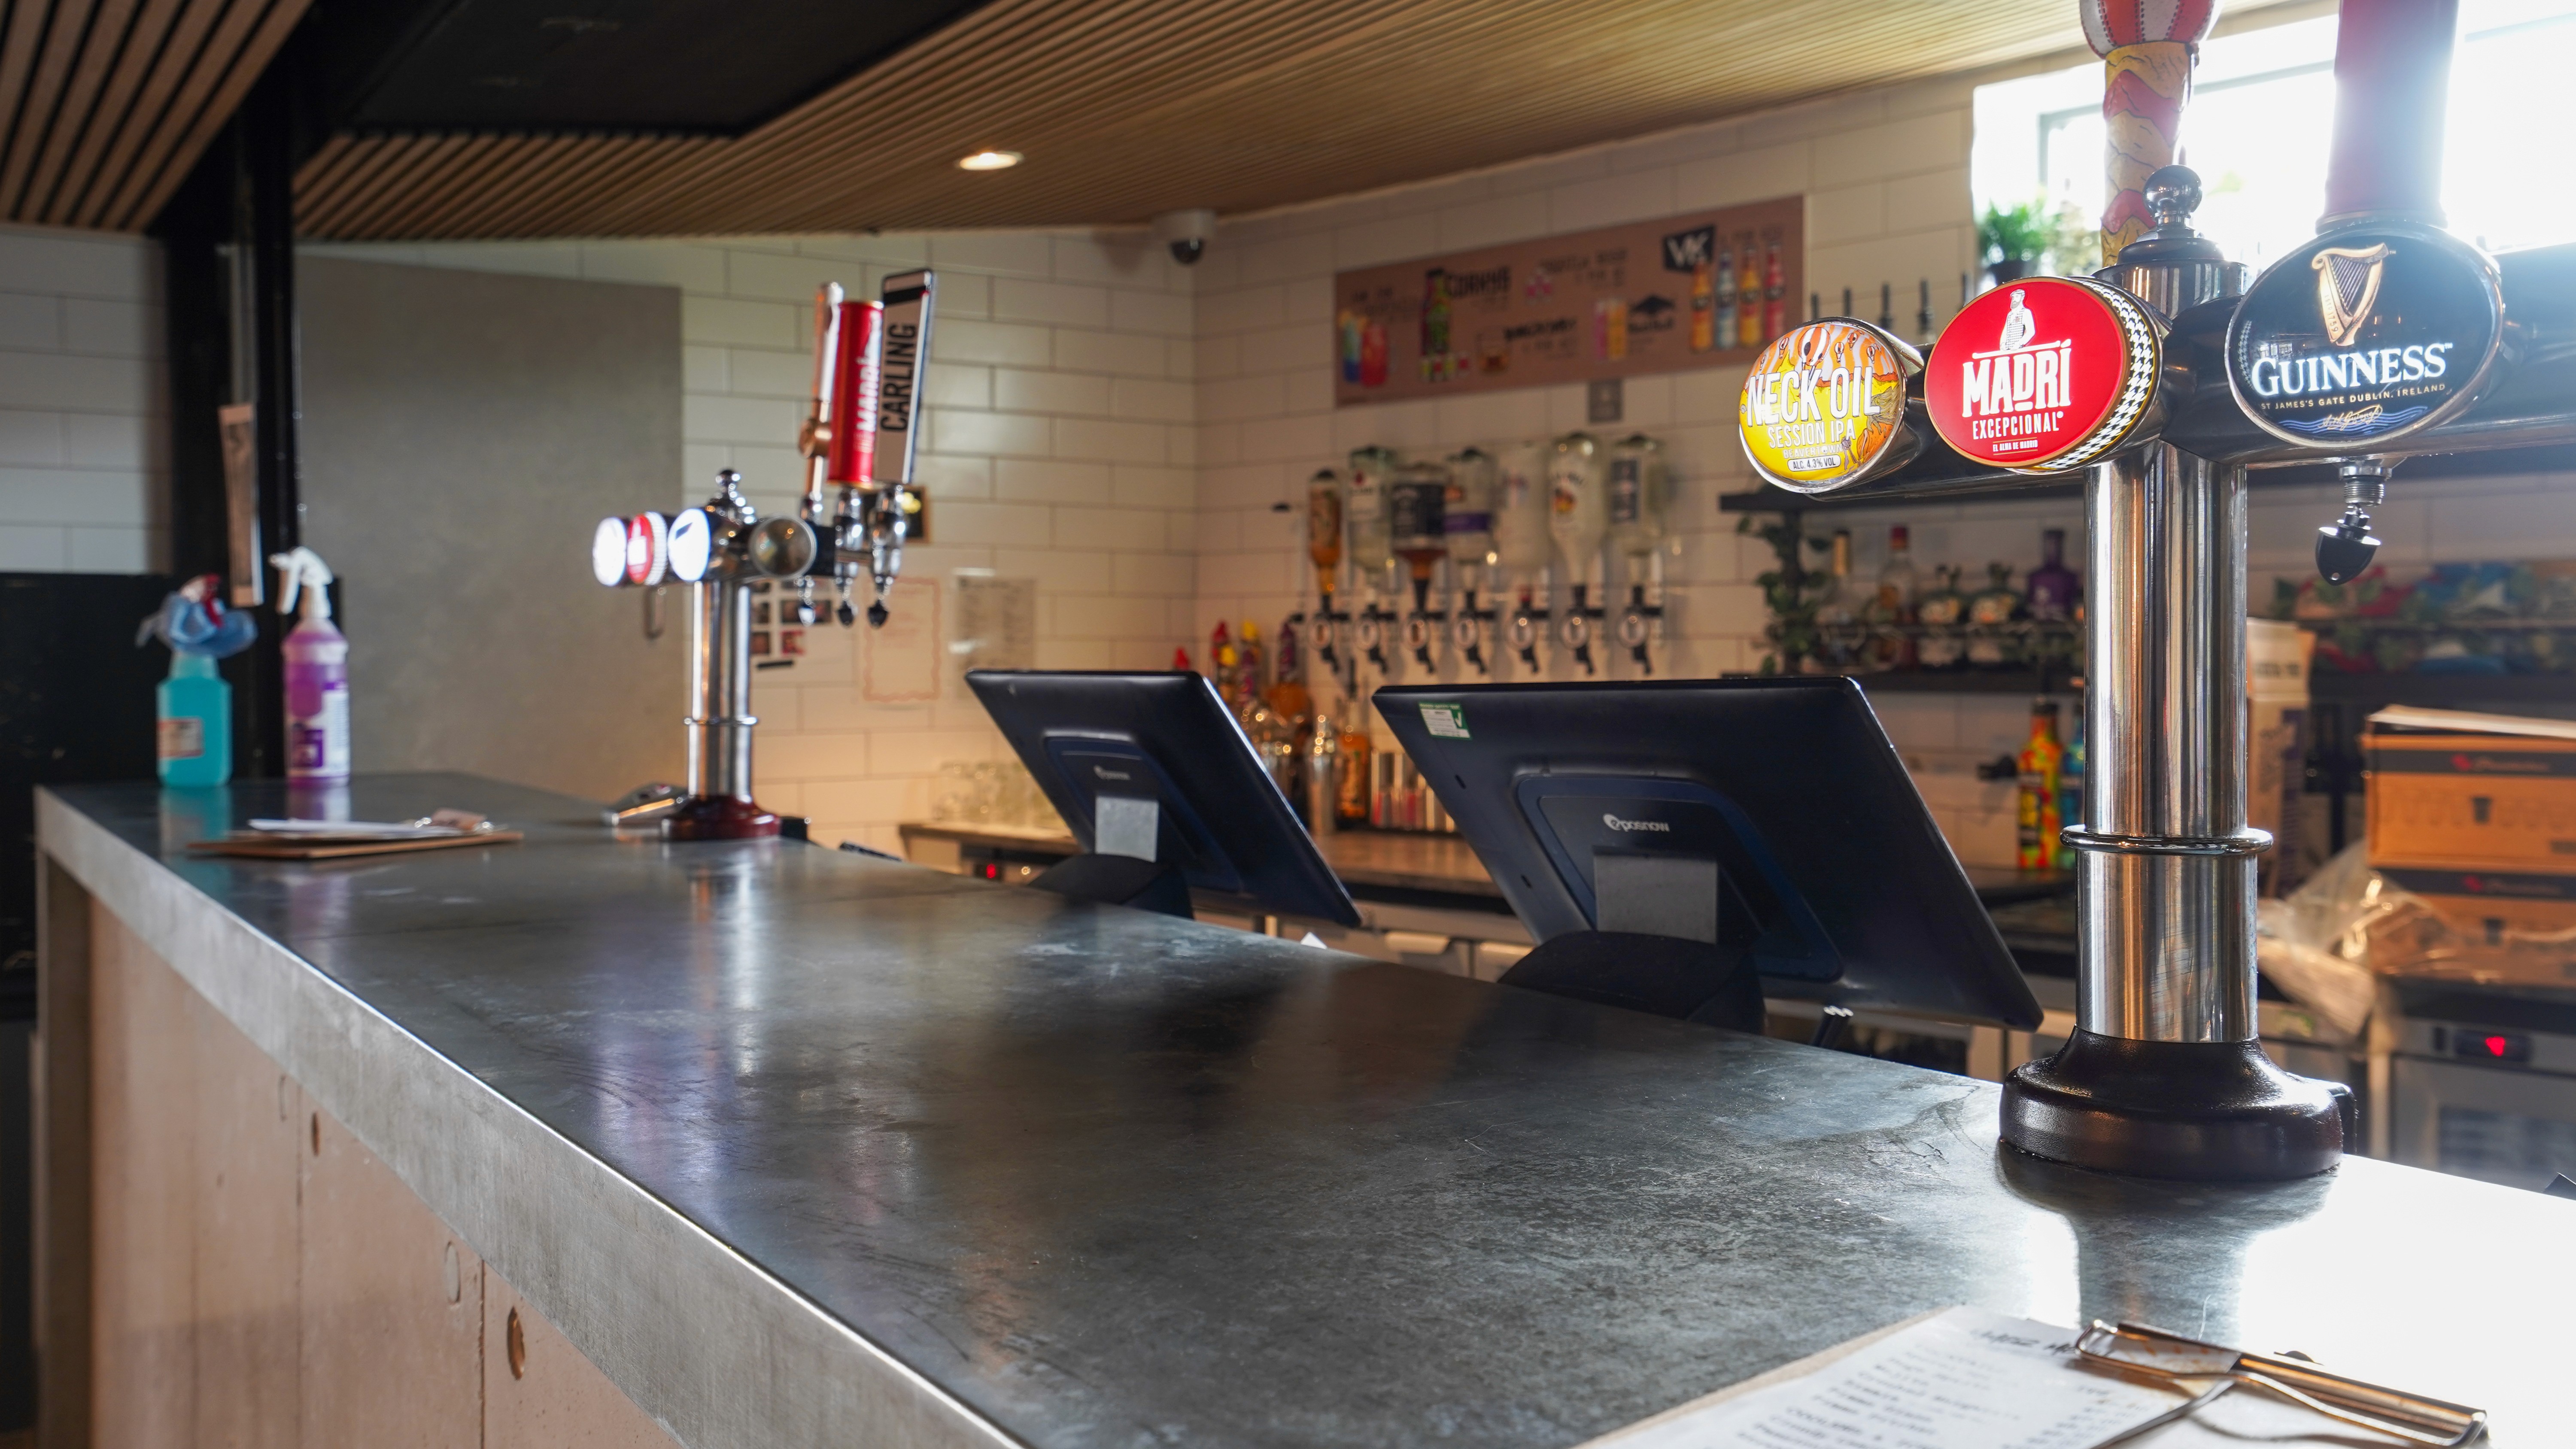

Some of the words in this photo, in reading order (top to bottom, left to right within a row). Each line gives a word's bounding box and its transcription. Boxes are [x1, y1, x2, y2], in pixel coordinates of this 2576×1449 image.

[880, 324, 916, 431] CARLING
[1962, 339, 2071, 418] MADRÍ
[2251, 343, 2446, 396] GUINNESS
[1747, 369, 1822, 427] NECK
[1830, 366, 1880, 419] OIL
[2318, 397, 2345, 406] GATE
[2397, 384, 2445, 397] IRELAND
[1767, 421, 1826, 448] SESSION
[1831, 418, 1856, 442] IPA
[1972, 412, 2060, 440] EXCEPCIONAL
[1993, 444, 1999, 452] EL
[2013, 442, 2019, 450] DE
[1793, 461, 1806, 470] ALC.
[1807, 458, 1823, 469] 4.3%
[1824, 457, 1836, 467] VOL
